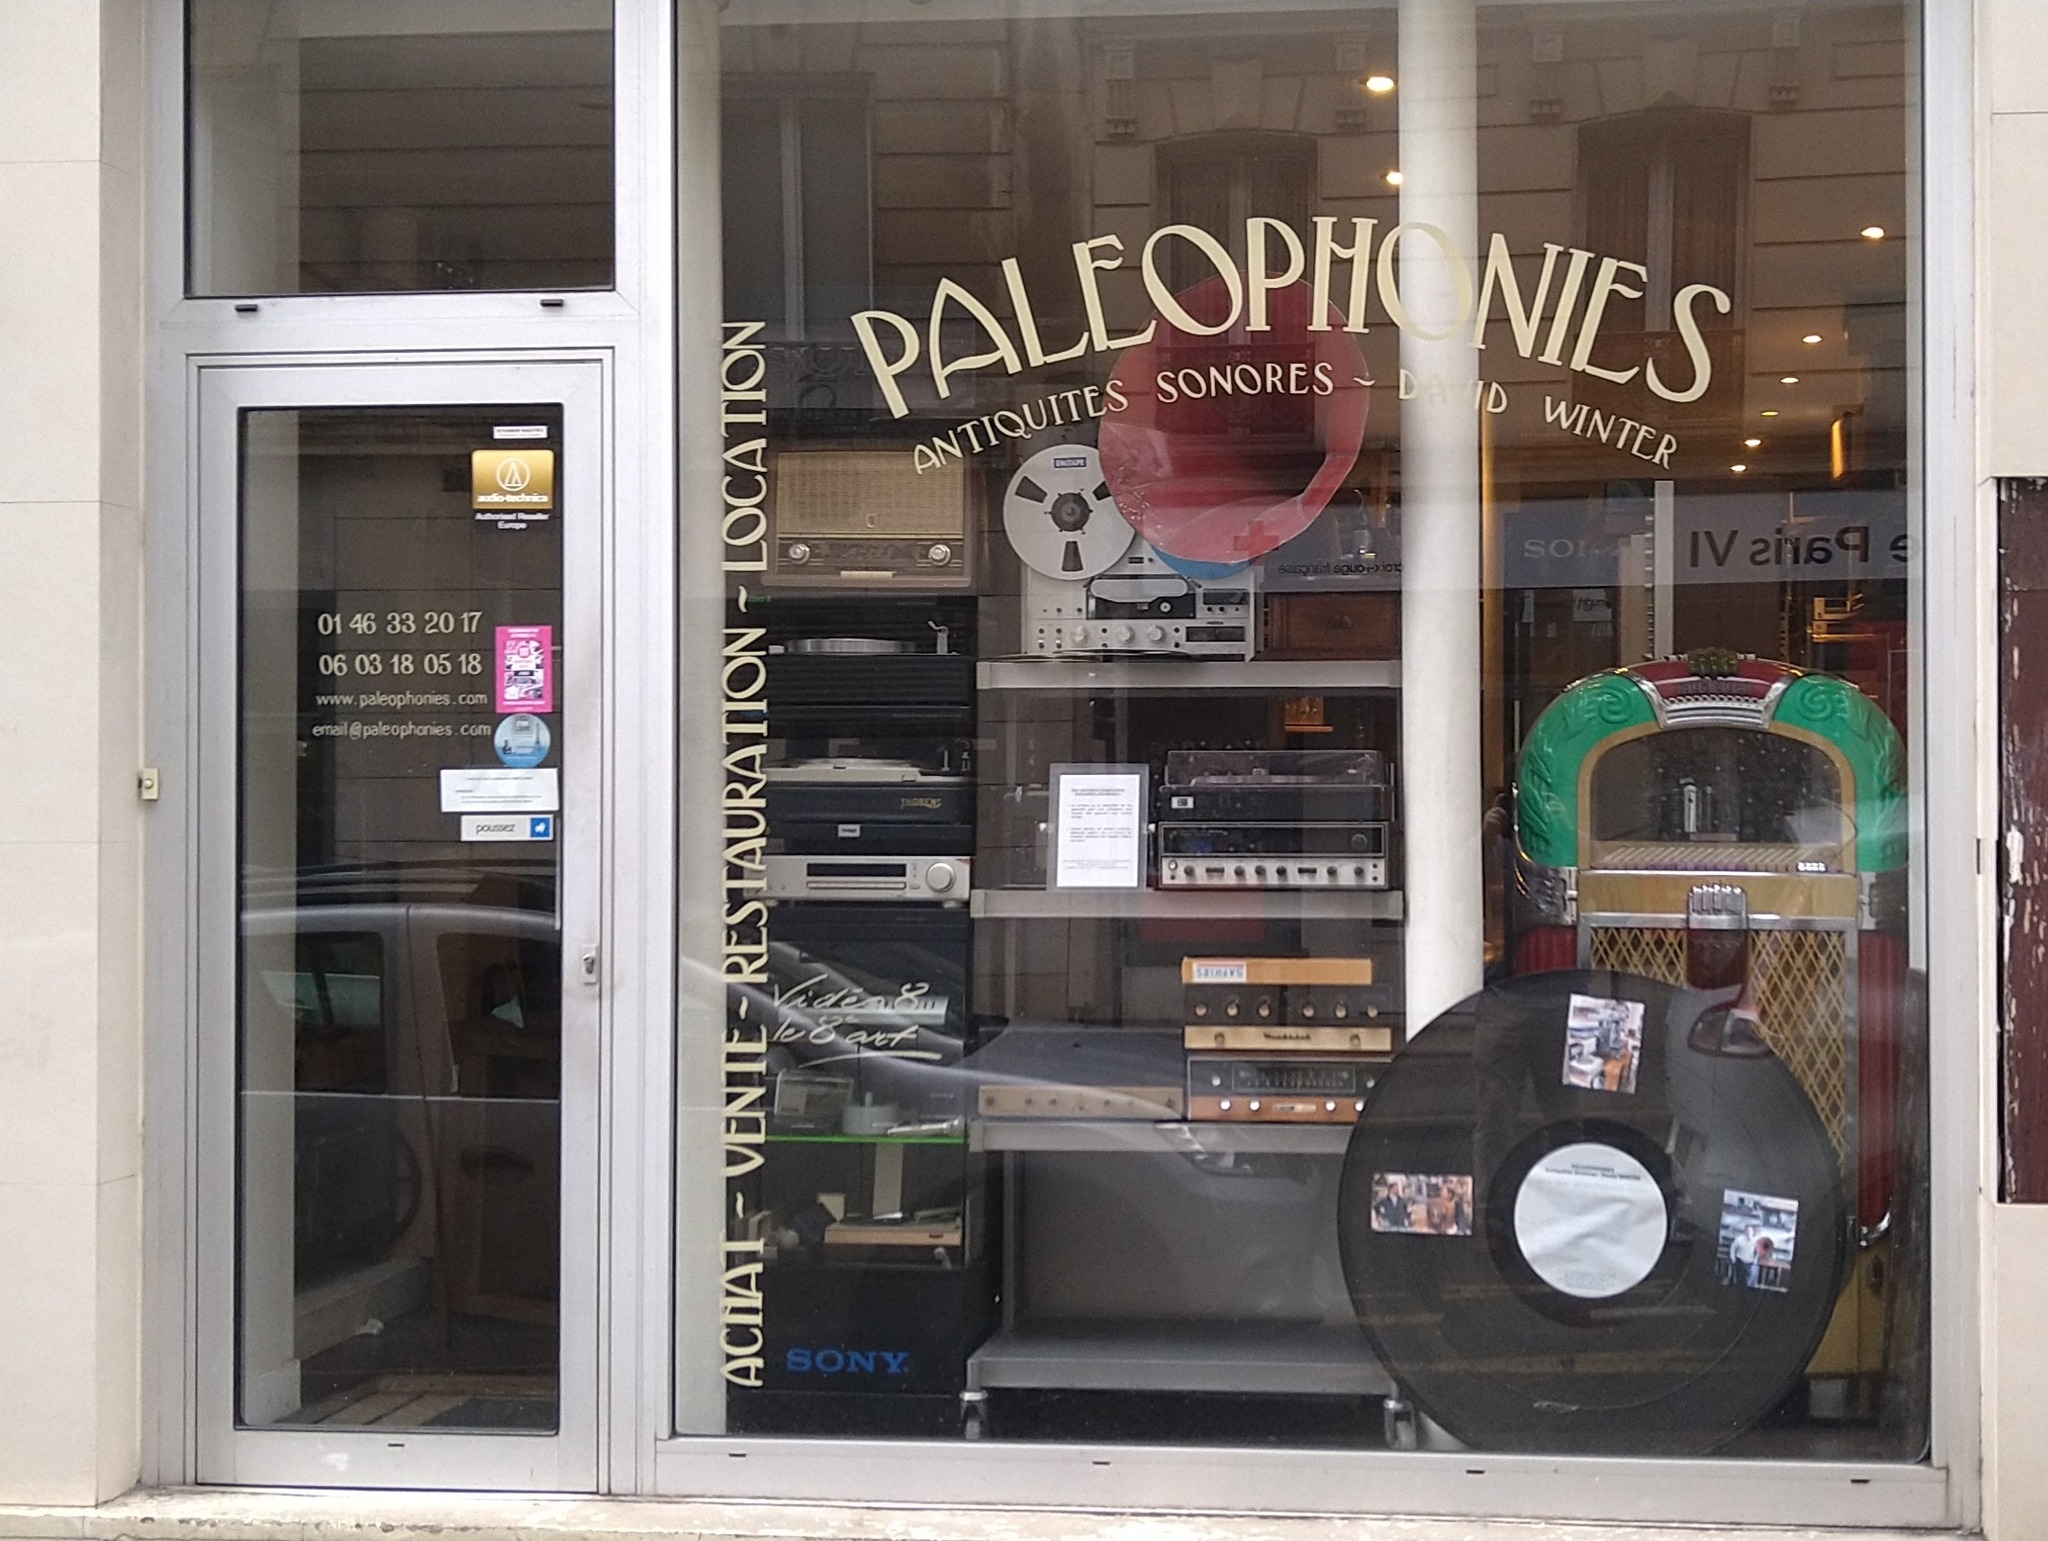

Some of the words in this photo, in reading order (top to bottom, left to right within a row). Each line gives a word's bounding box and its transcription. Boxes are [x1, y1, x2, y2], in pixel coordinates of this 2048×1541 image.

[850, 216, 1731, 419] PALEOPHONIES
[721, 321, 768, 572] LOCATION
[913, 379, 1129, 475] ANTIQUITES
[1156, 362, 1334, 403] SONORES
[1544, 395, 1677, 470] WINTER
[318, 613, 342, 635] 01
[349, 612, 377, 634] 46
[386, 612, 416, 634] 33
[424, 612, 455, 634] 20
[460, 612, 483, 633] 17
[319, 654, 348, 676] 06
[355, 654, 383, 675] 03
[390, 654, 414, 675] 18
[424, 653, 452, 675] 05
[458, 653, 483, 675] 18
[475, 823, 516, 836] poussez
[721, 627, 768, 984] RESTAURATION
[720, 1023, 767, 1179] VENTE
[719, 1228, 765, 1388] ACHAT
[785, 1347, 909, 1375] SONY
